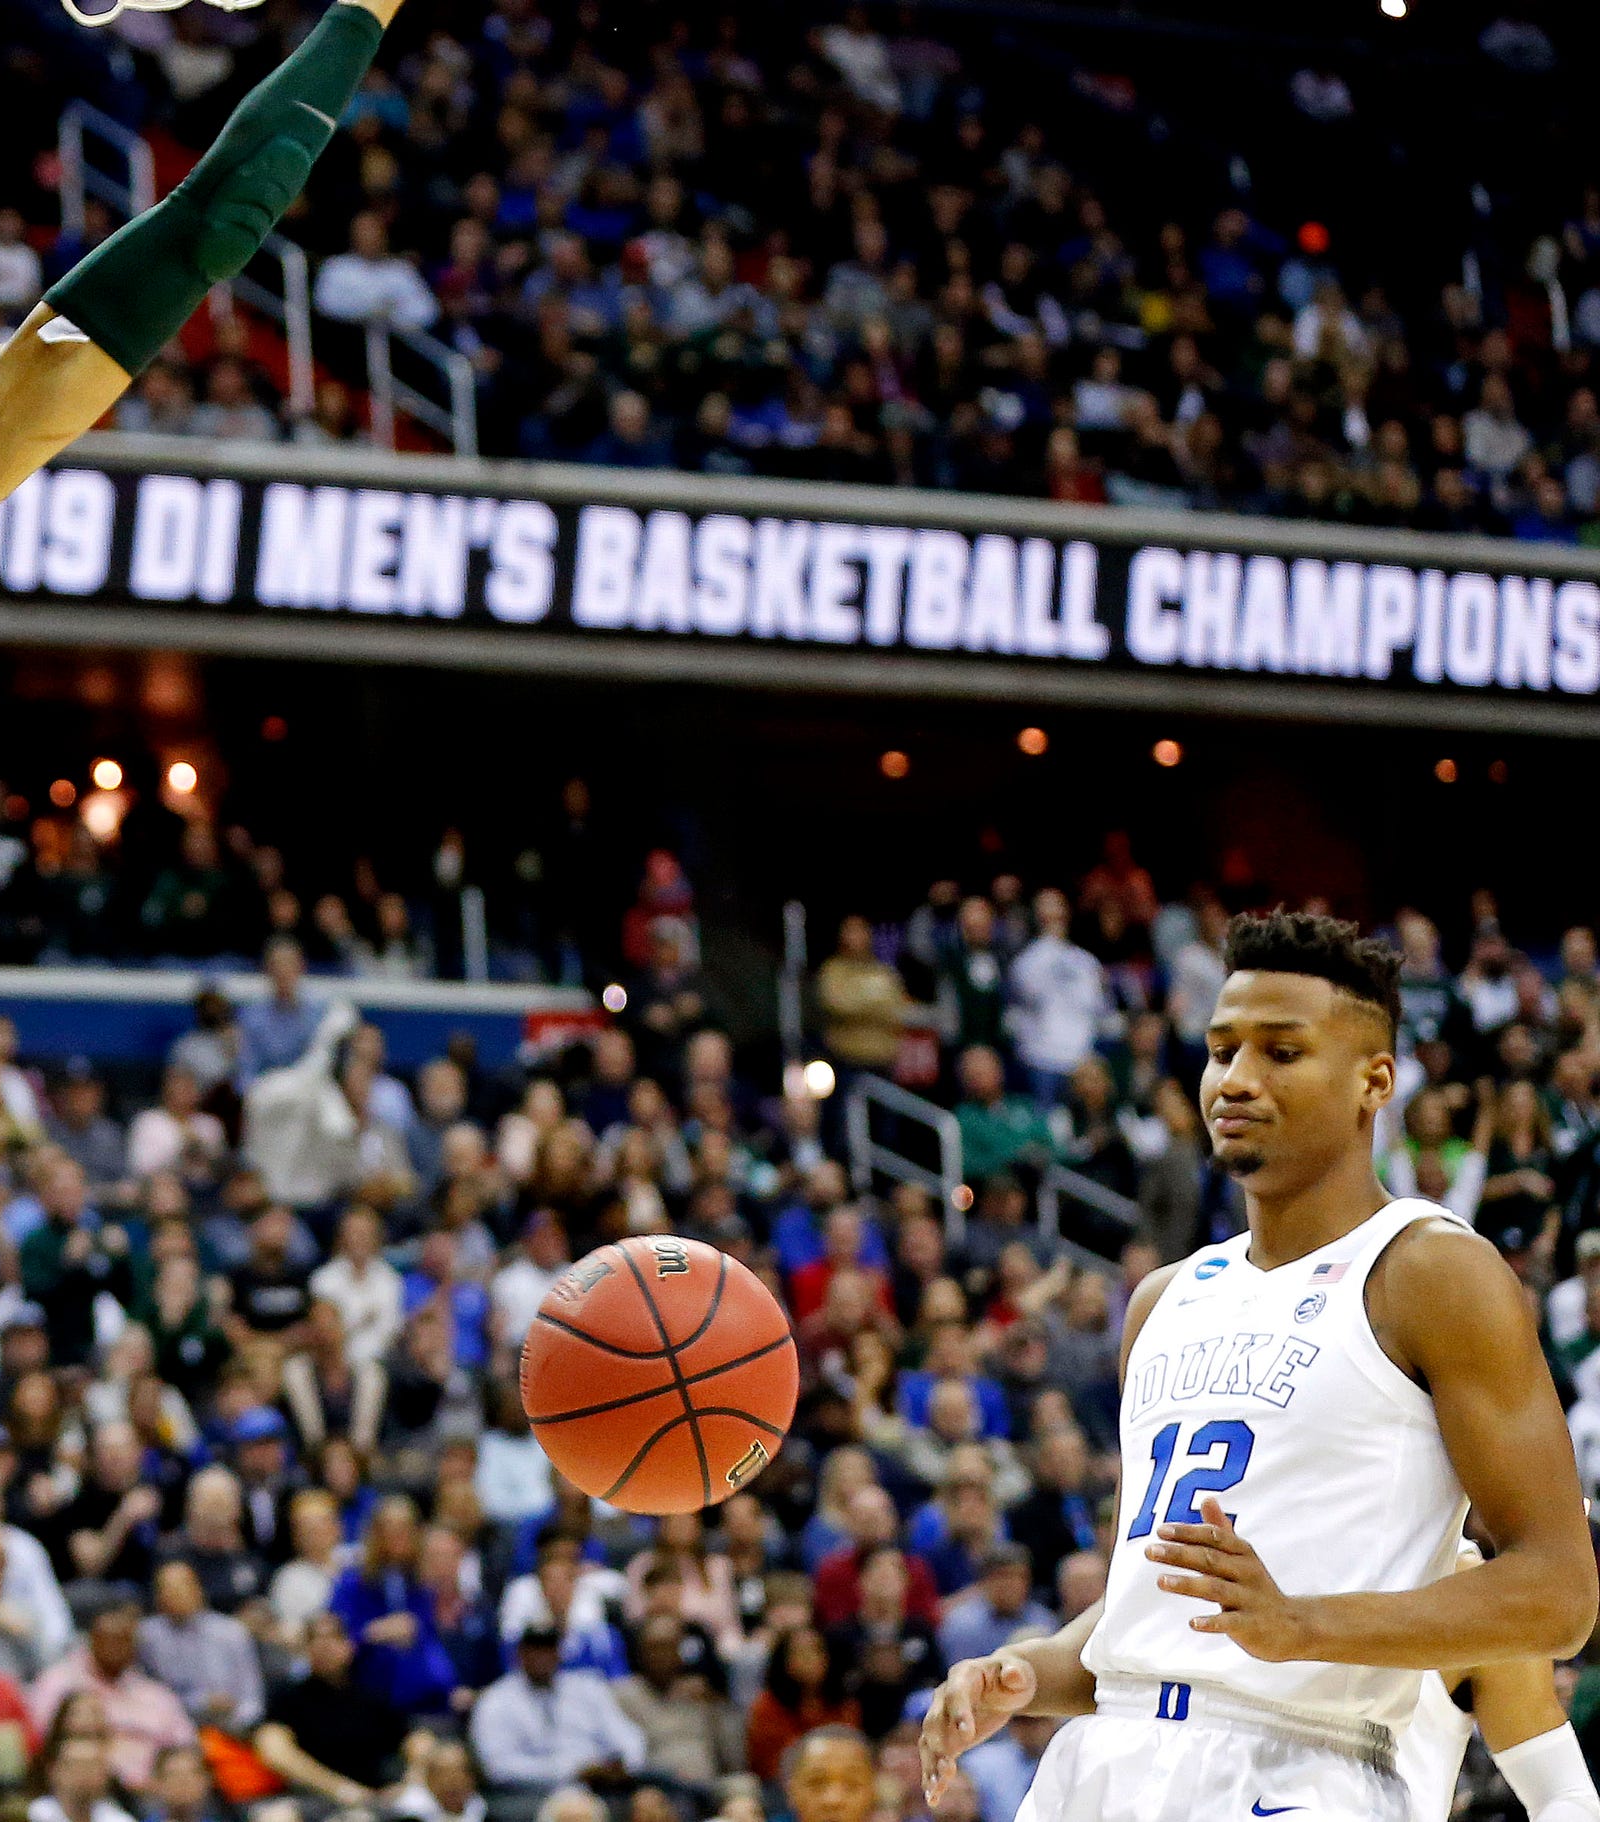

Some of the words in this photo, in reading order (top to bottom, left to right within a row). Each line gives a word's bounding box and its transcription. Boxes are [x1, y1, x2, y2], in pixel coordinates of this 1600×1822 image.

[127, 473, 243, 604] DI
[253, 481, 558, 625] MEN'S
[571, 504, 1111, 662] BASKETBALL
[1124, 546, 1600, 695] CHAMPIONS
[1130, 1333, 1321, 1423] DUKE
[1127, 1419, 1256, 1541] 12
